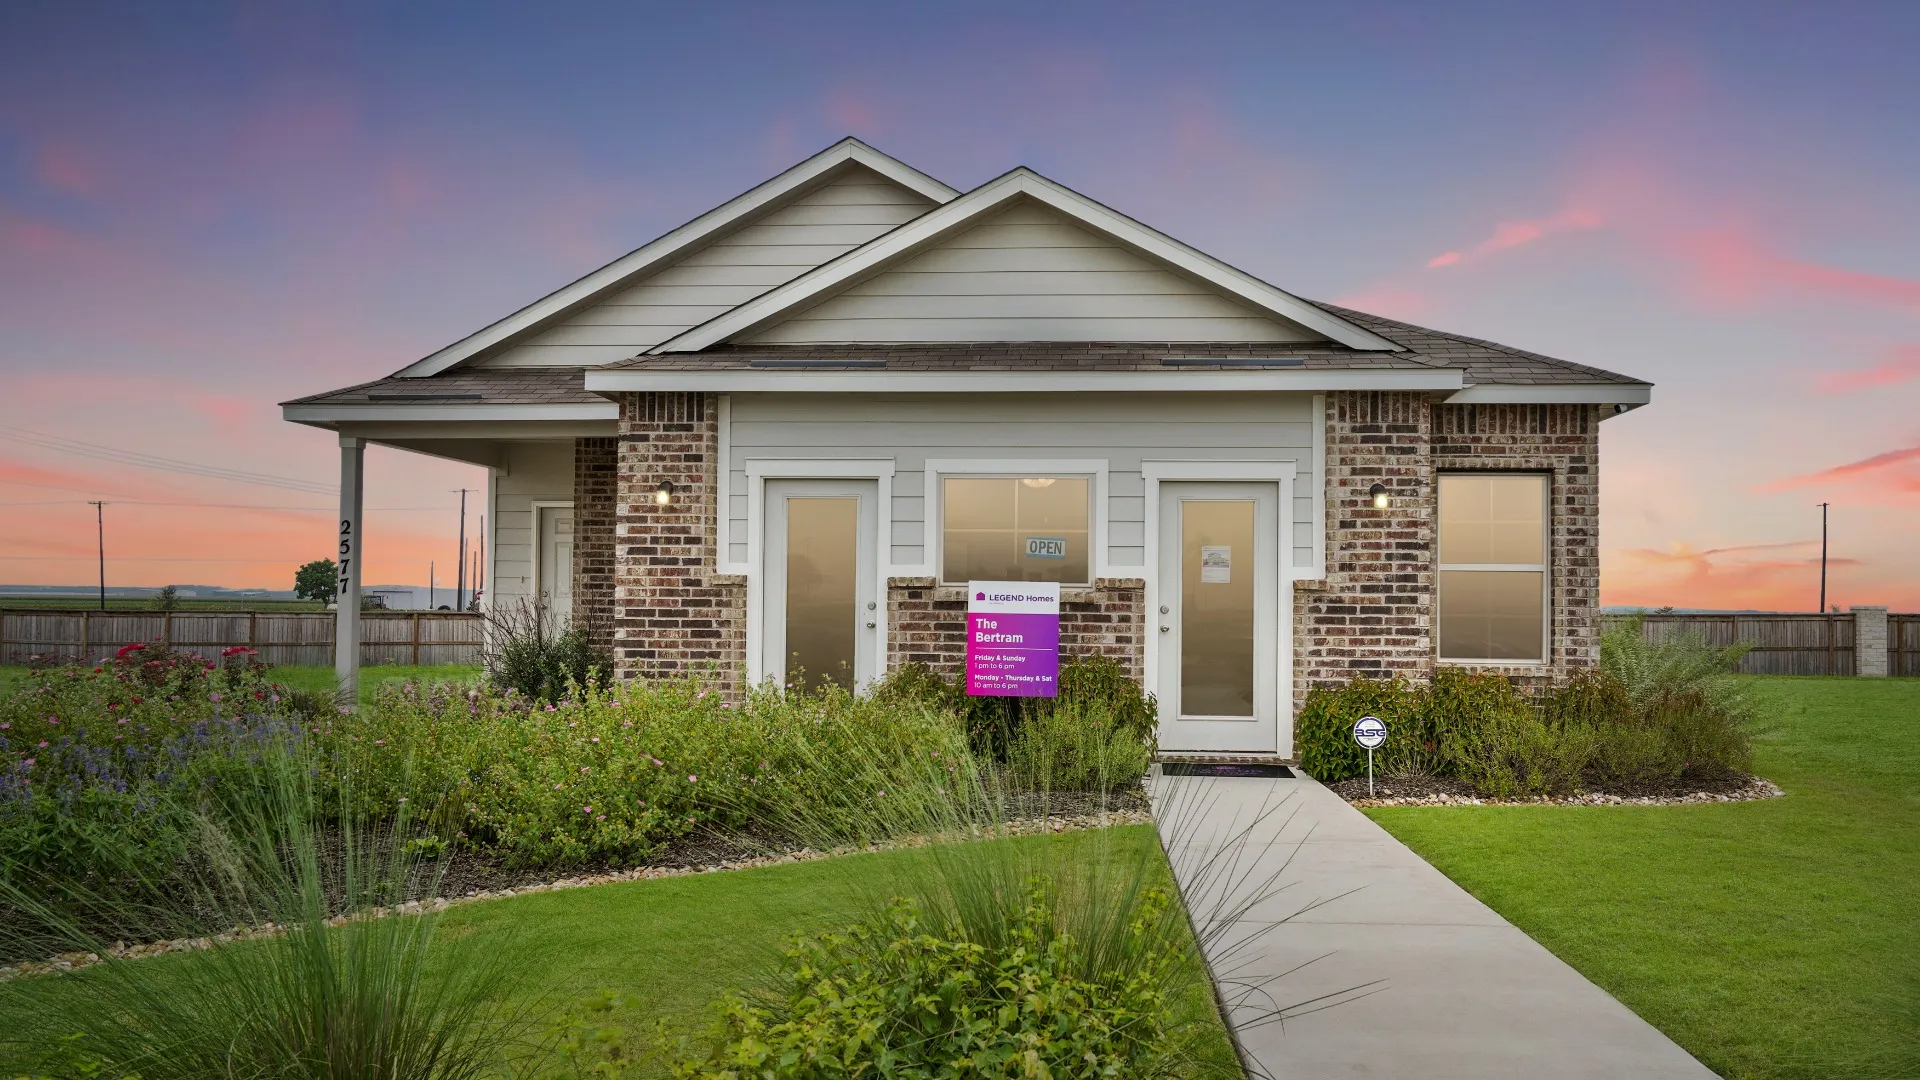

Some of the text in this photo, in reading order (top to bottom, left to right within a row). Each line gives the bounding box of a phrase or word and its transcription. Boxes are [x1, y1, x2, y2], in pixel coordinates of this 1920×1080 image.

[1030, 540, 1062, 555] OPEN
[340, 519, 351, 594] 2577
[989, 594, 1024, 602] LEGEND
[975, 619, 998, 629] The
[975, 632, 1023, 643] Bertram
[974, 654, 994, 662] Friday
